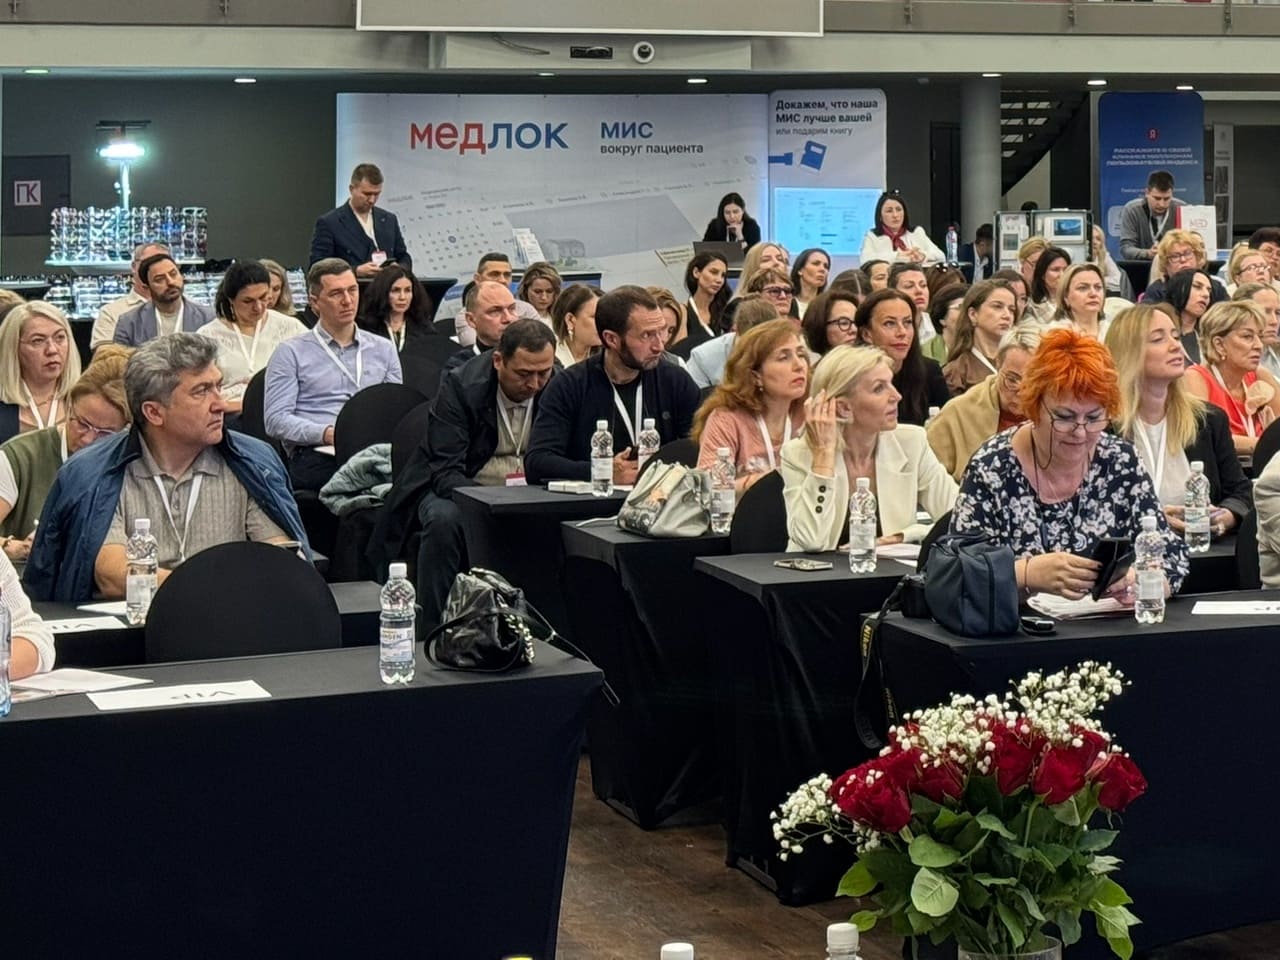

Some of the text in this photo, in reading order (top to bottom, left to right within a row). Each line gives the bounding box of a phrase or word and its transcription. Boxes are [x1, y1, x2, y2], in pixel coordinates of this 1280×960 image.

[776, 100, 878, 111] Докажем, что наша
[776, 112, 872, 124] МИС лучше вашей
[601, 121, 653, 138] МИС
[793, 128, 828, 136] подарим
[830, 127, 853, 136] книгу
[601, 143, 704, 155] вокруг пациента
[17, 183, 40, 203] ПК
[863, 624, 872, 657] Nikon
